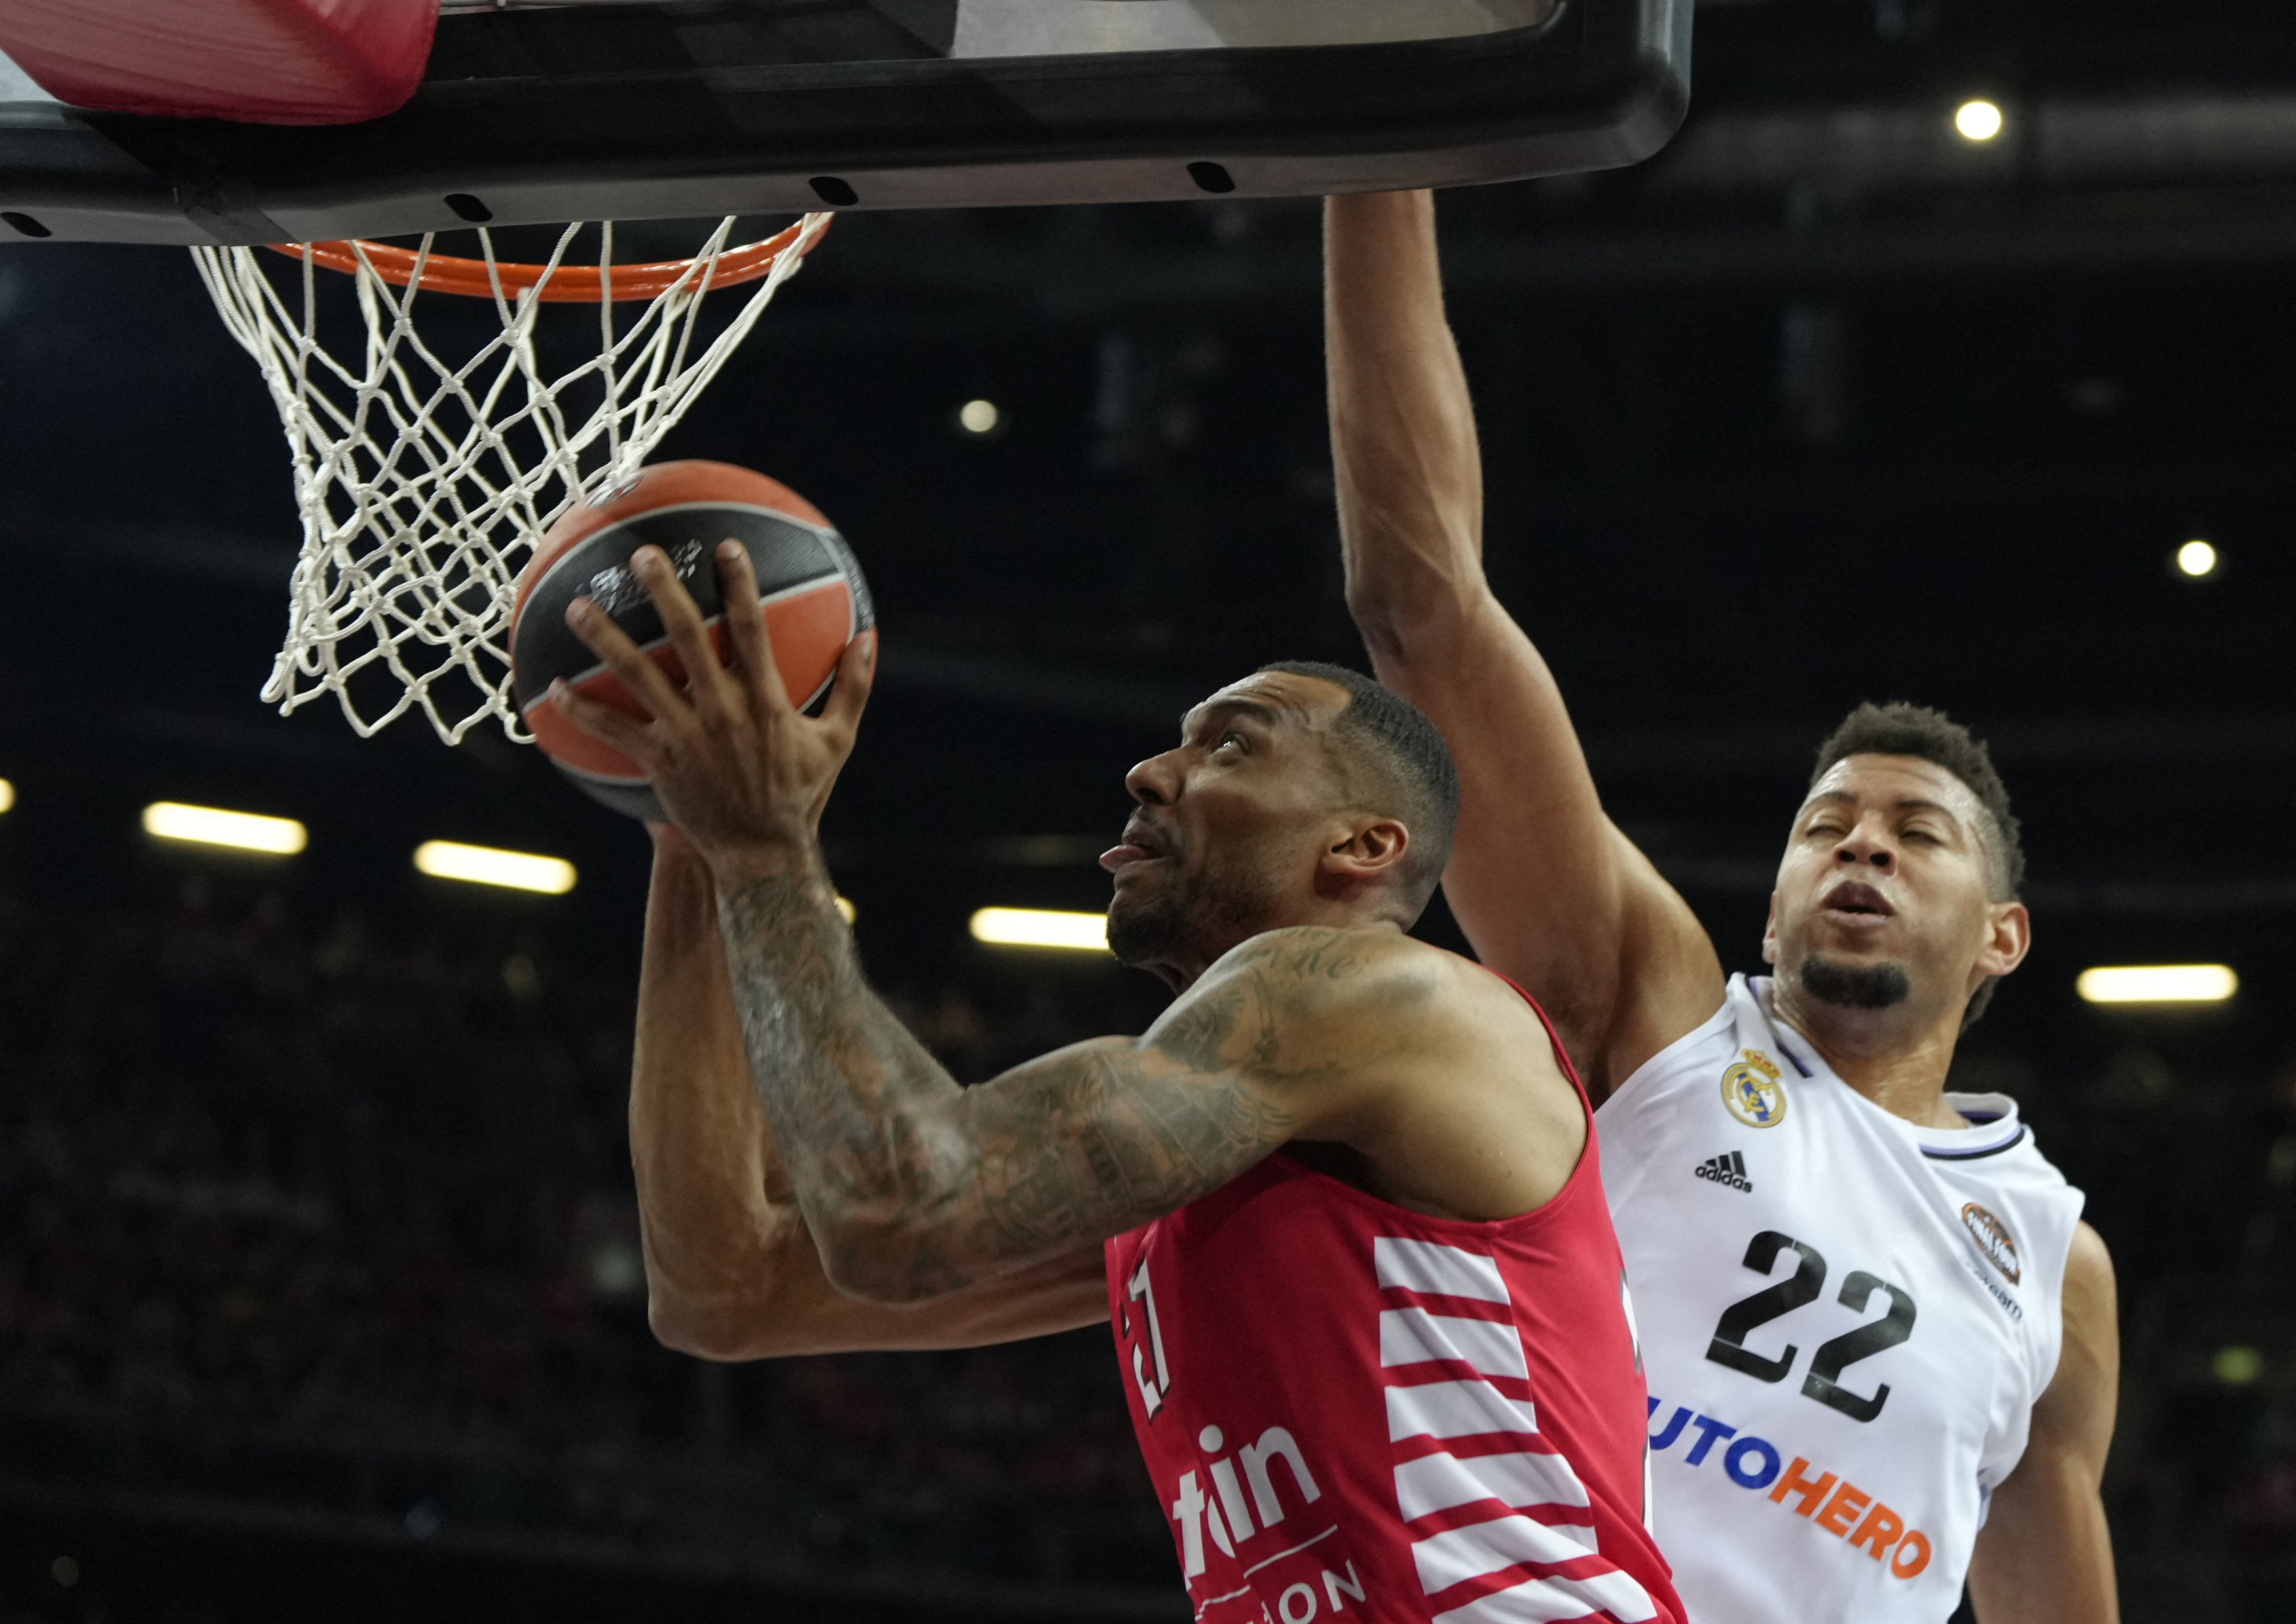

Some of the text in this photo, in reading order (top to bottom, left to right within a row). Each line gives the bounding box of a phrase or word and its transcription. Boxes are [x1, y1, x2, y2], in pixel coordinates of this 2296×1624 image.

[1694, 1166, 1752, 1193] adidas
[1705, 1230, 1917, 1424] 22
[1647, 1395, 1933, 1579] UTOHERO
[1261, 1559, 1366, 1624] ON
